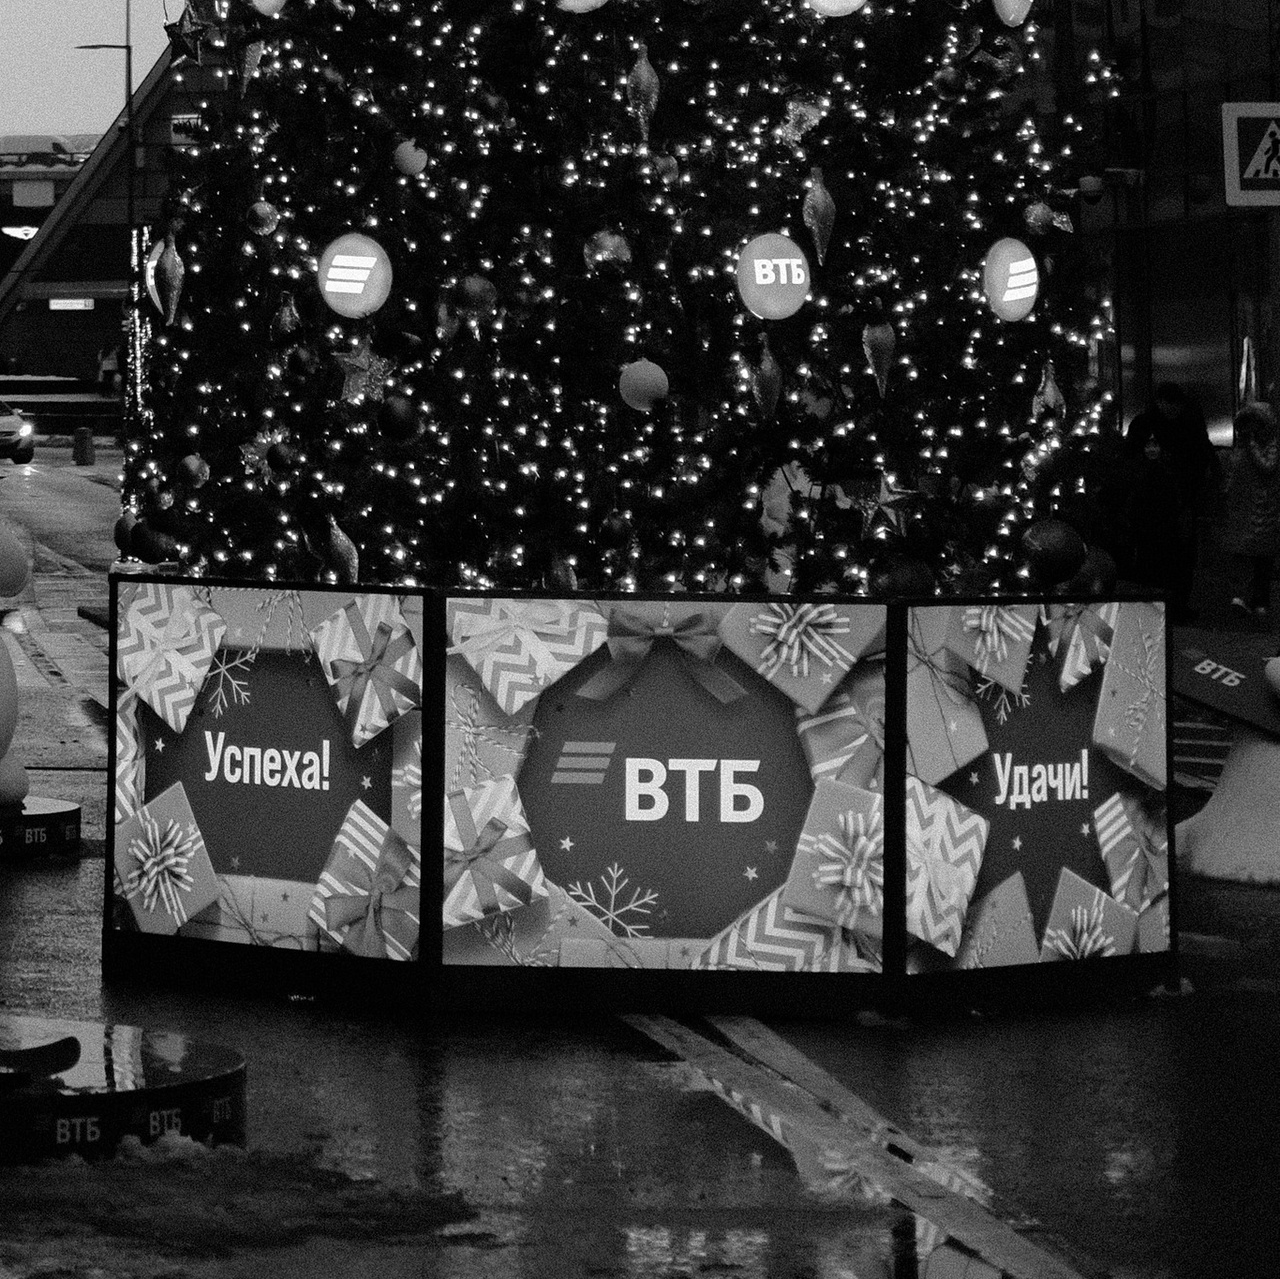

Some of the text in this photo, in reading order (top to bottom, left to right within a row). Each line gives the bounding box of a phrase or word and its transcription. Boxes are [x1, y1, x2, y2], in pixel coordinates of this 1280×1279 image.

[753, 258, 806, 285] ВТБ
[1193, 658, 1247, 687] ВТБ
[204, 730, 331, 792] Успеха!
[624, 757, 766, 823] ВТБ
[993, 749, 1090, 811] Удачи!
[25, 827, 48, 844] ВТБ
[56, 1117, 101, 1144] ВТБ
[149, 1108, 182, 1136] ВТБ
